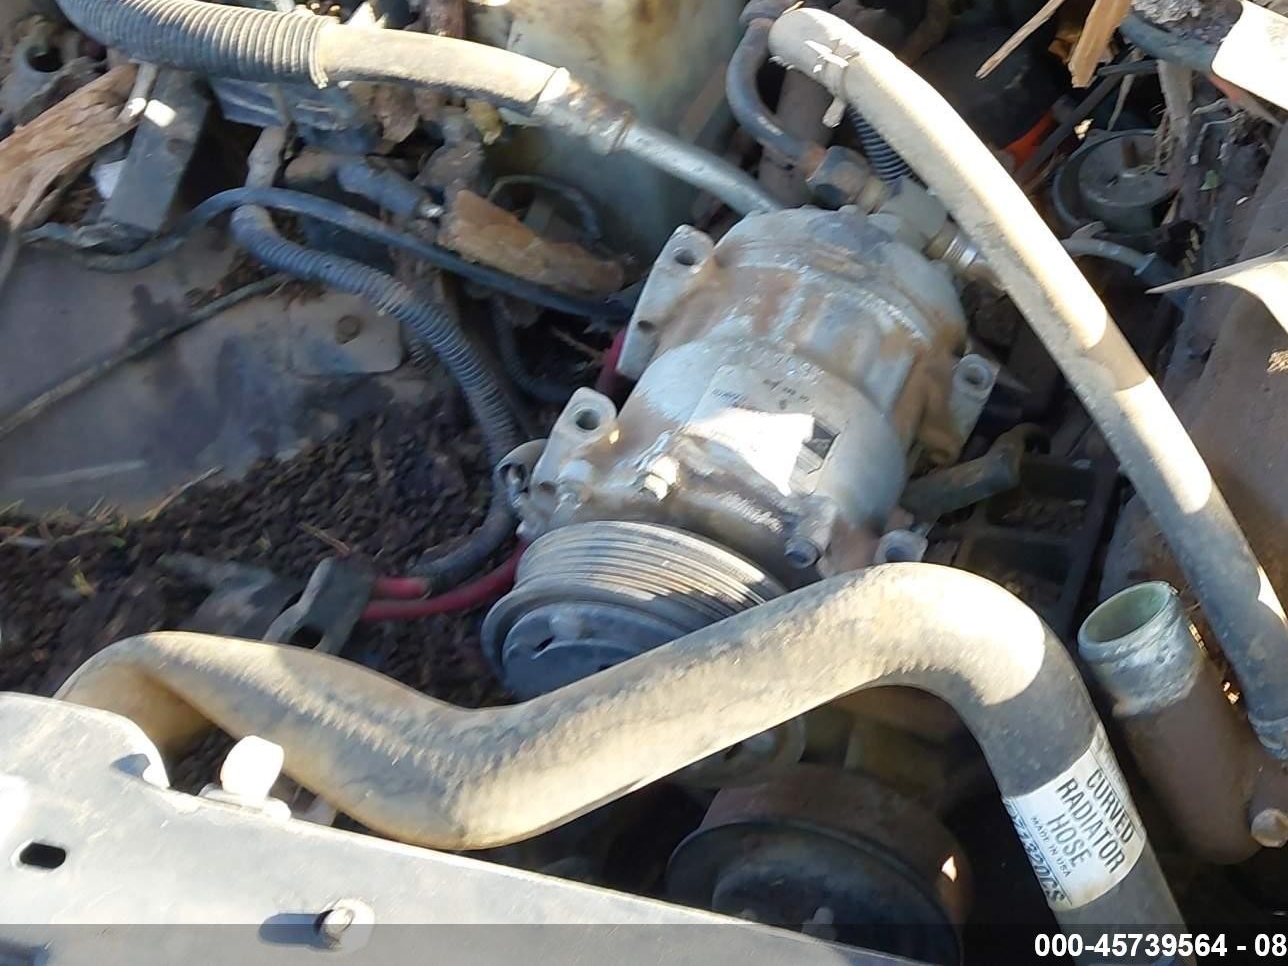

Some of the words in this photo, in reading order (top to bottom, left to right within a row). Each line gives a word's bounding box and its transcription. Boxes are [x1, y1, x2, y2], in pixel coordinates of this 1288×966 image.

[1046, 813, 1091, 868] HOSE
[1056, 777, 1126, 874] RADIATOR
[1086, 769, 1135, 844] CURVED
[1030, 815, 1049, 842] MADE
[1049, 844, 1058, 856] IN
[1056, 857, 1072, 877] USA
